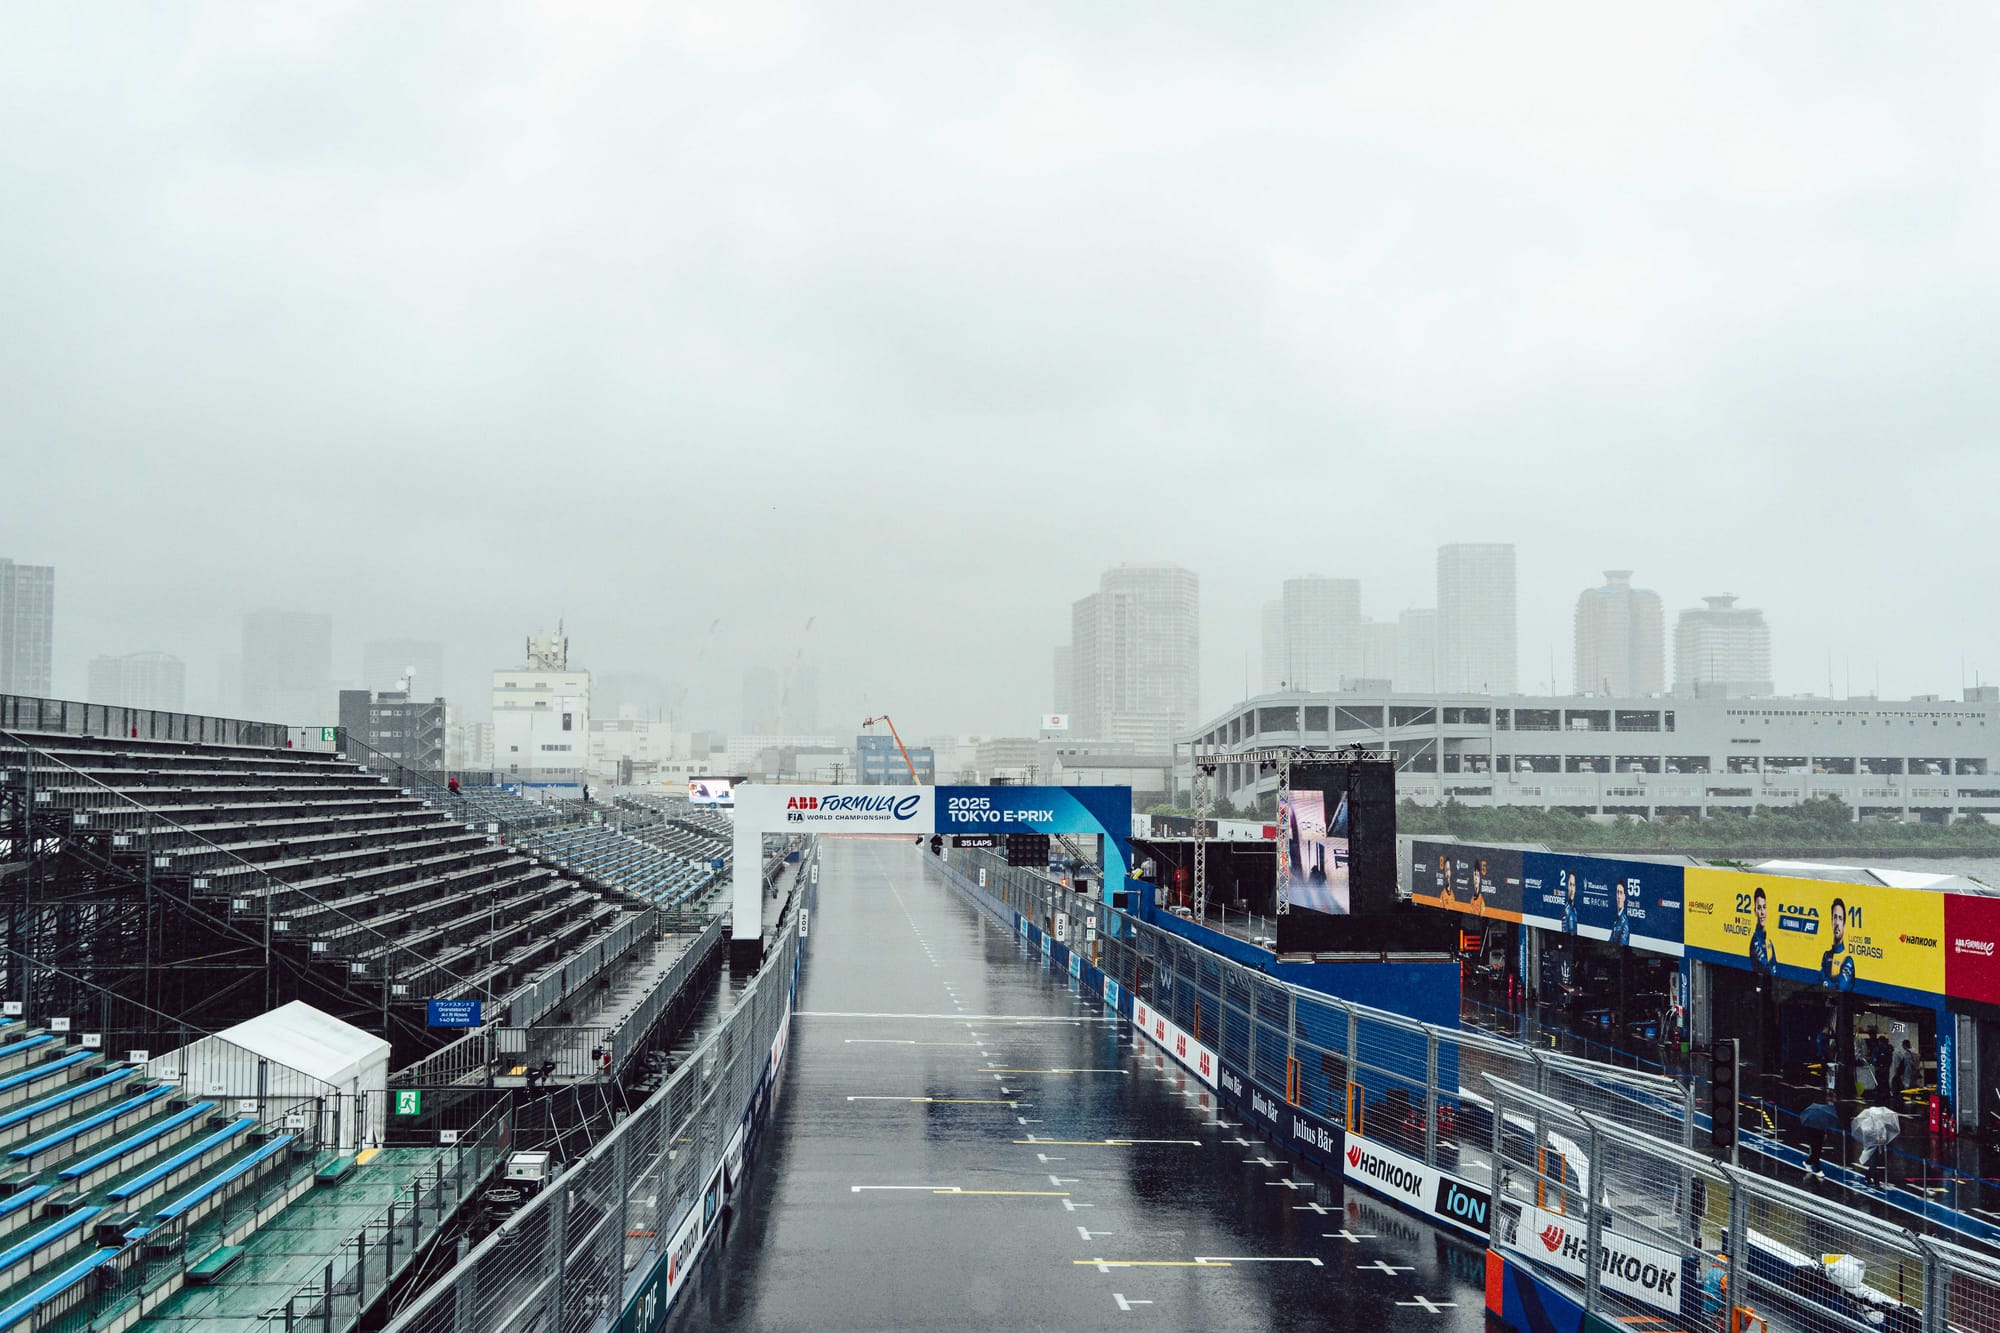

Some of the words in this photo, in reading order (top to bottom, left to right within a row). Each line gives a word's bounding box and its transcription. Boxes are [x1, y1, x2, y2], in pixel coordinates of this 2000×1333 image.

[787, 796, 819, 810] ABB
[819, 794, 896, 812] FORMULA
[948, 797, 991, 810] 2025
[948, 810, 1001, 823] TOKYO
[1003, 810, 1054, 823] E-PRIX
[961, 839, 972, 847] 35
[972, 839, 993, 847] LAPS
[1559, 869, 1566, 886] 2
[1627, 878, 1641, 897] 55
[1736, 893, 1752, 914] 22
[1778, 903, 1820, 918] LOLA
[1848, 905, 1863, 929] 11
[1723, 923, 1752, 937] MALONEY
[1848, 943, 1856, 955] DI
[1856, 945, 1883, 959] GRASSI
[1138, 1004, 1146, 1027] ABB
[1155, 1018, 1165, 1042] ABB
[1176, 1032, 1187, 1059] ABB
[1199, 1049, 1211, 1078] ABB
[1221, 1066, 1234, 1092] Julius
[1233, 1076, 1243, 1097] Bär
[1252, 1088, 1268, 1117] Julius
[1267, 1099, 1279, 1123] Bär
[1293, 1114, 1316, 1145] Julius
[1317, 1126, 1334, 1153] Bär
[644, 1280, 658, 1333] PIF
